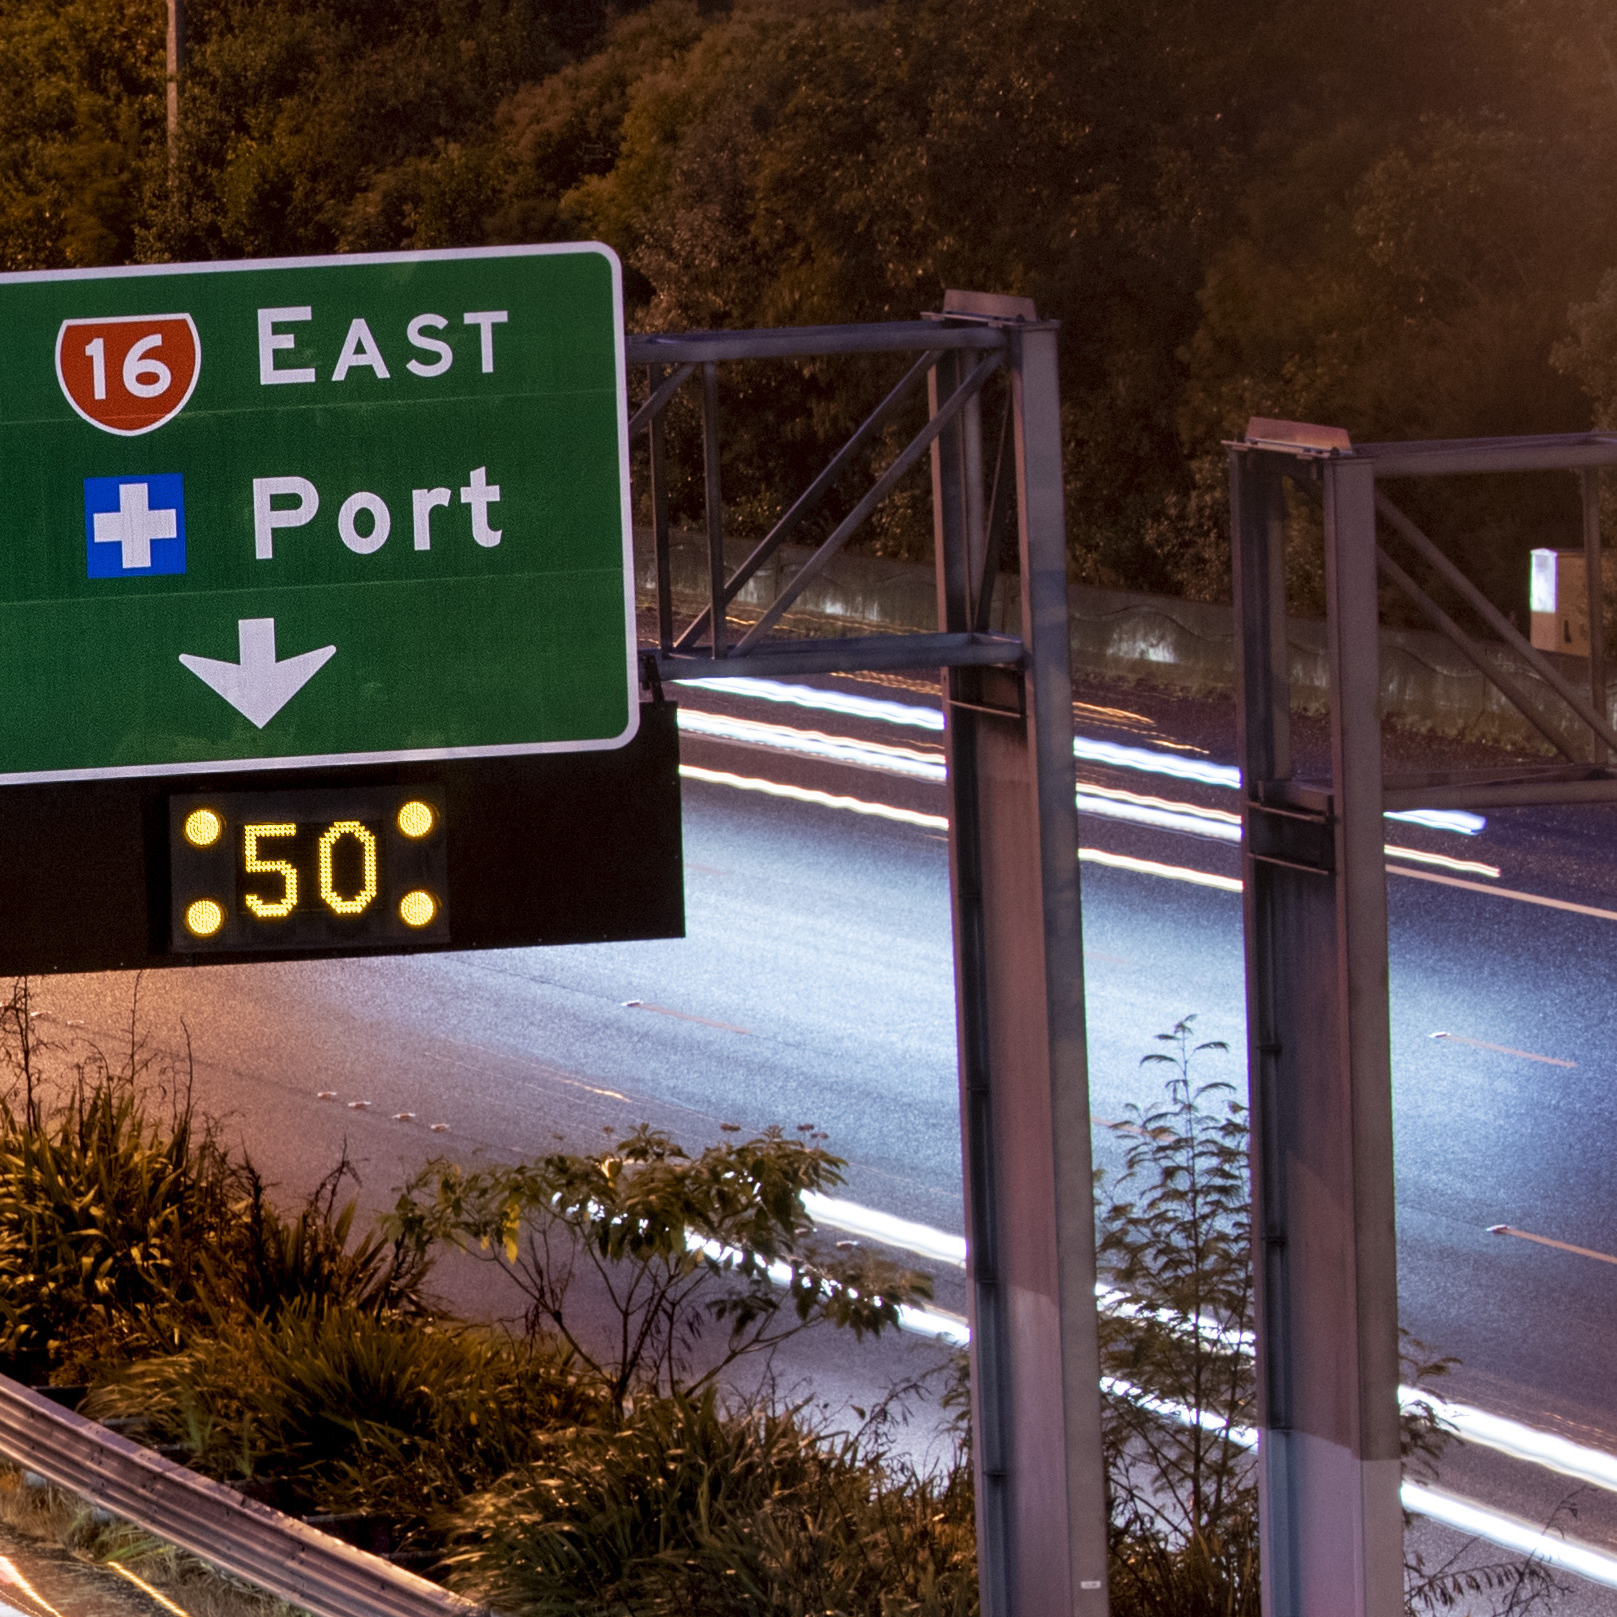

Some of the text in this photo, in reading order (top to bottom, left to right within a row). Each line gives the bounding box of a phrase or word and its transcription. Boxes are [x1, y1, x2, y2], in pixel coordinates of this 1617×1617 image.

[84, 333, 172, 401] 16
[257, 305, 509, 386] EAST
[252, 465, 503, 560] Port
[244, 820, 377, 918] 50
